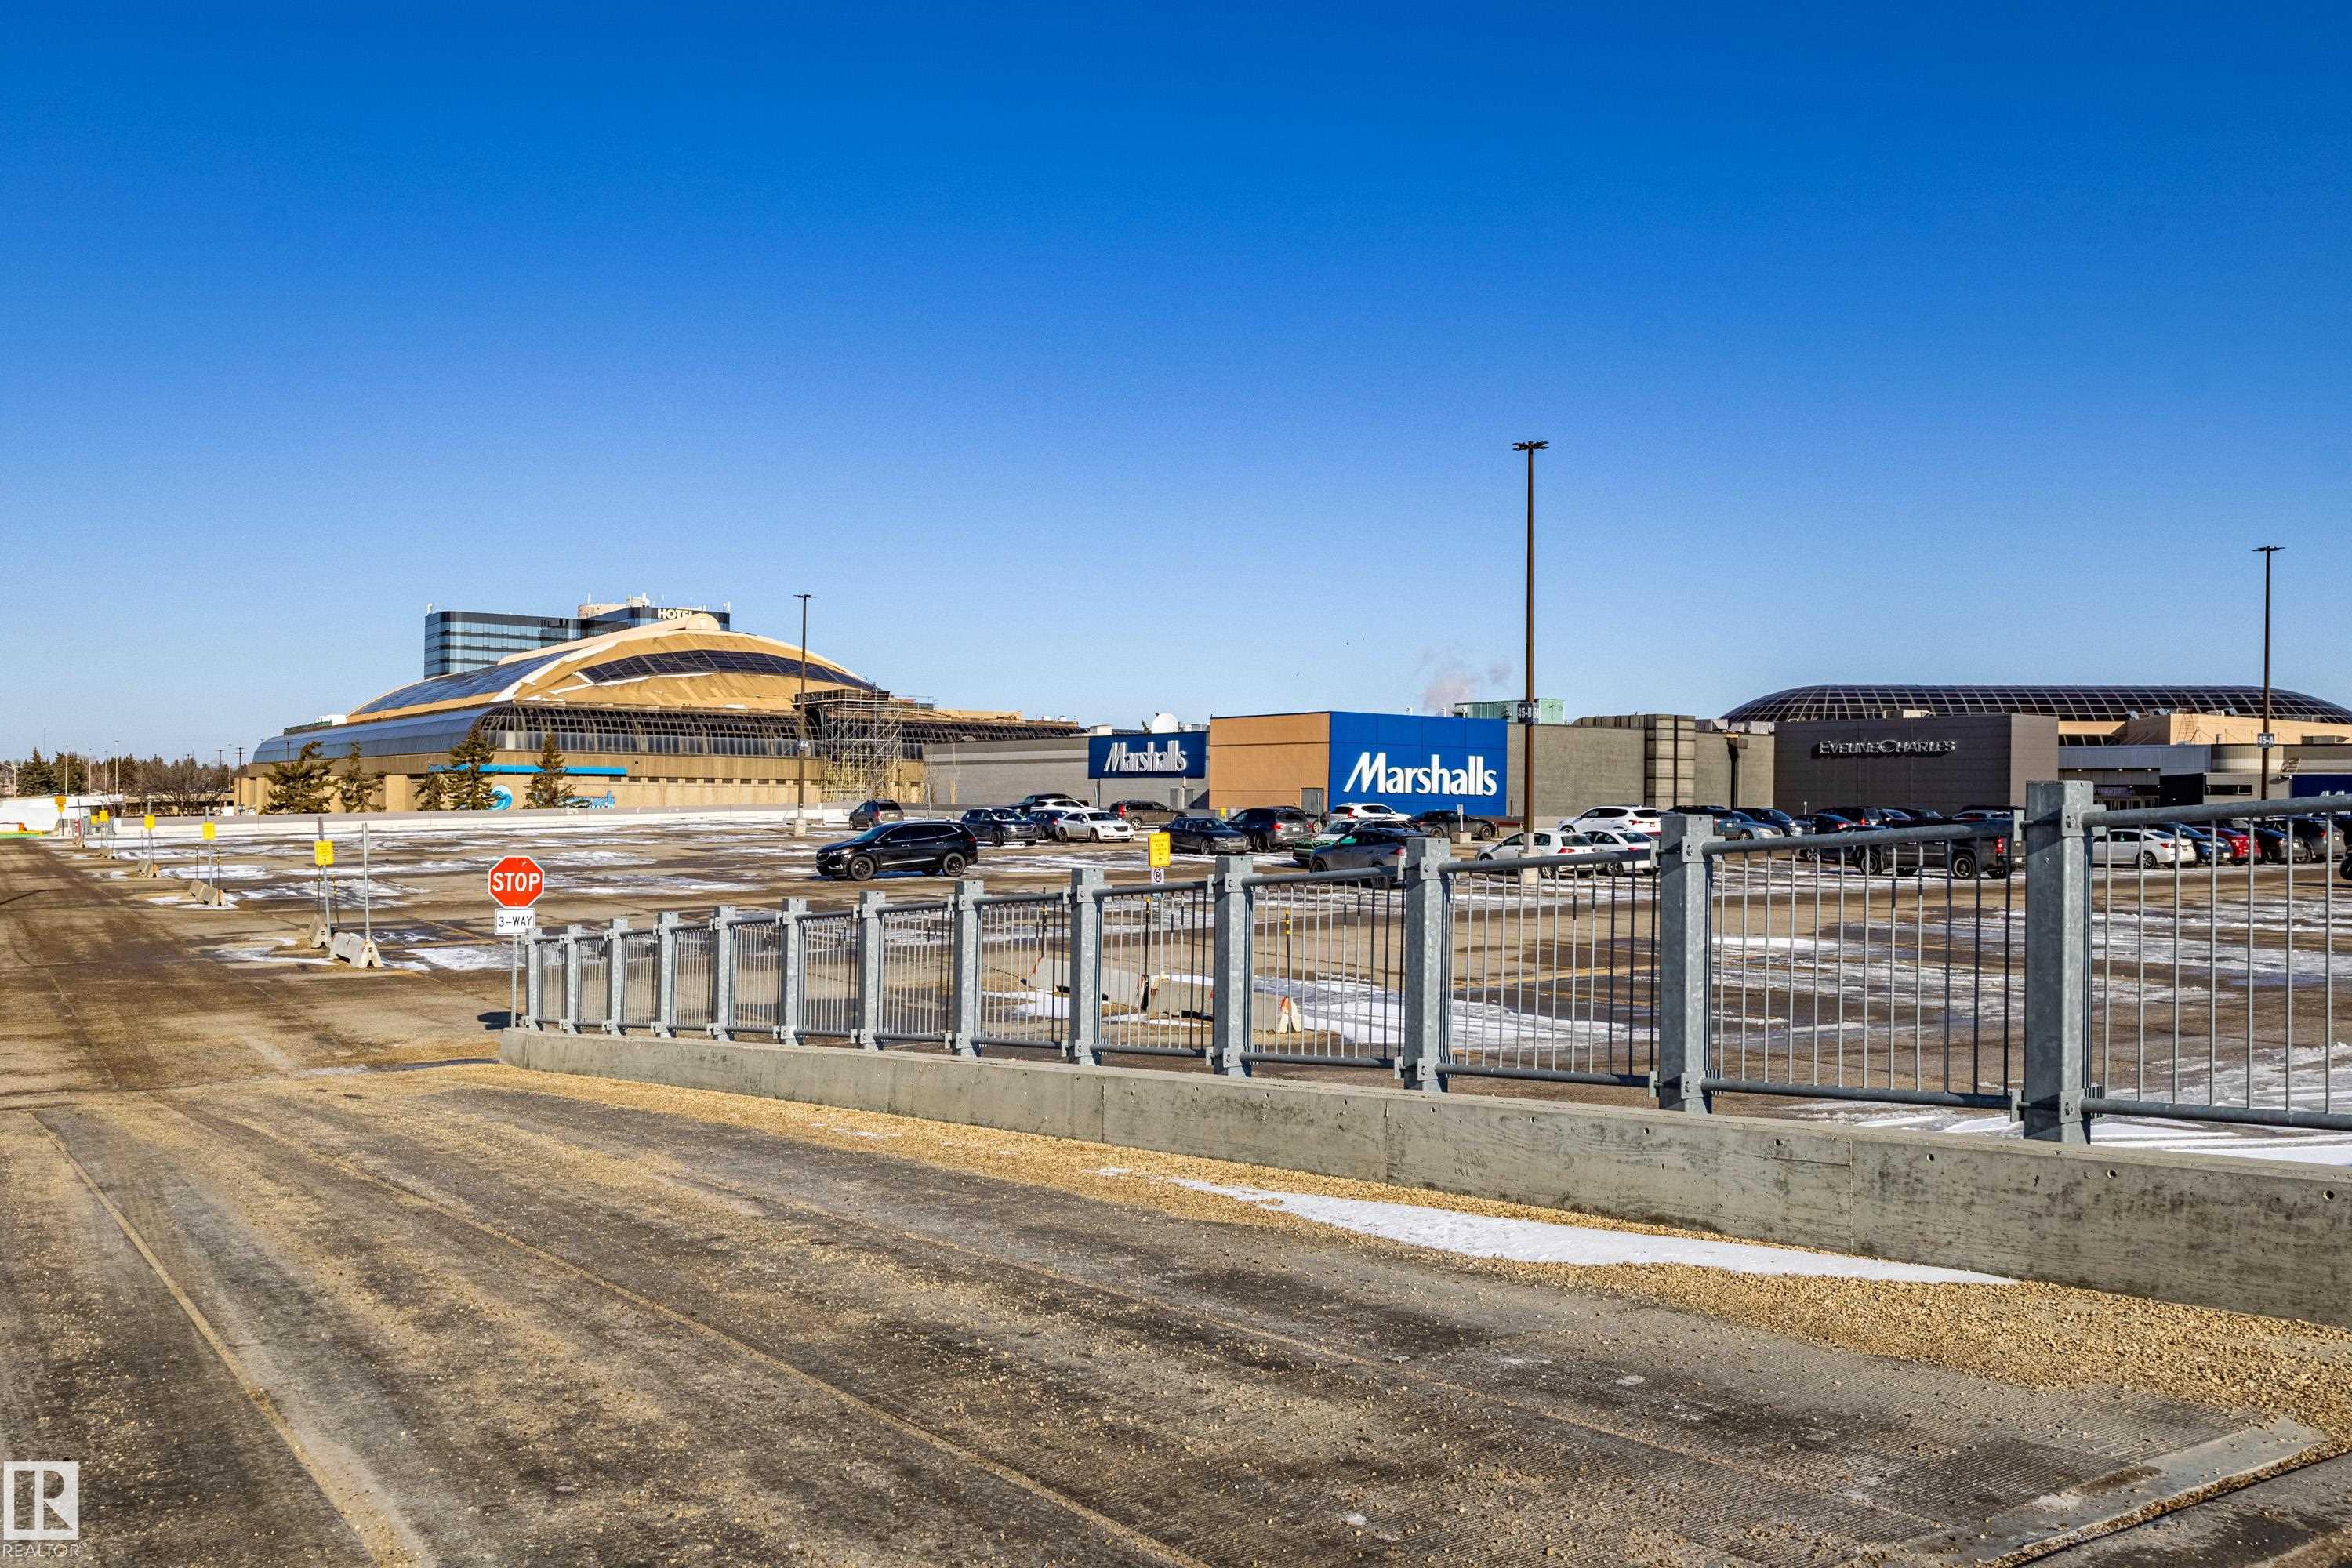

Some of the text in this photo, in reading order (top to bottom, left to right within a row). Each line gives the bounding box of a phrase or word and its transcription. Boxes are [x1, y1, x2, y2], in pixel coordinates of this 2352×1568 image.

[1518, 707, 1532, 718] 45-B
[1104, 740, 1187, 771] Marshalls
[1343, 752, 1497, 796] Marshalls
[492, 872, 540, 891] STOP
[499, 916, 532, 927] 3-WAY
